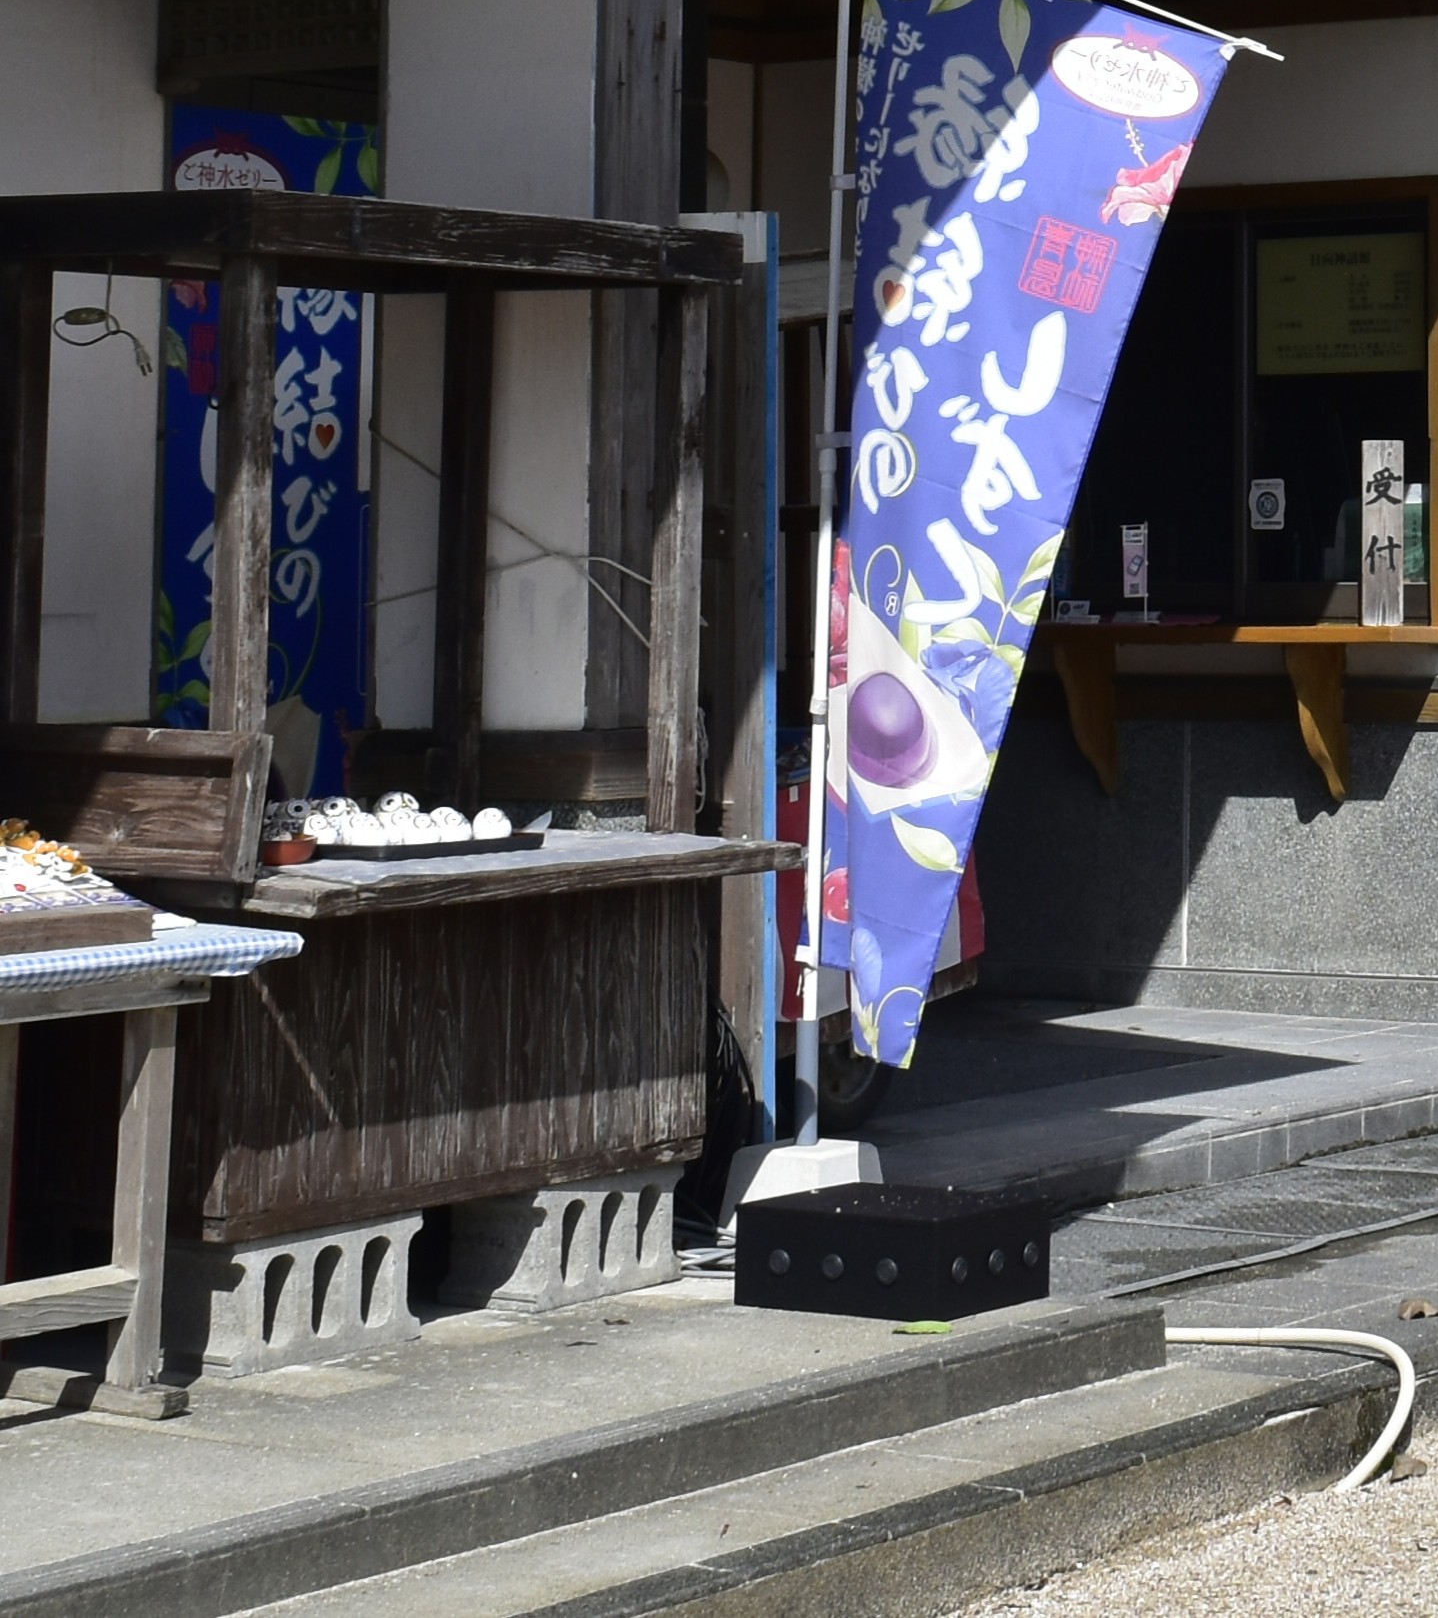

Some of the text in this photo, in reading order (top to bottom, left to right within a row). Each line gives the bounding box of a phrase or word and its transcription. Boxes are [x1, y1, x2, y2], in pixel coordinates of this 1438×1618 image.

[183, 161, 277, 188] ご神水ゼリー
[1365, 466, 1402, 575] 受付
